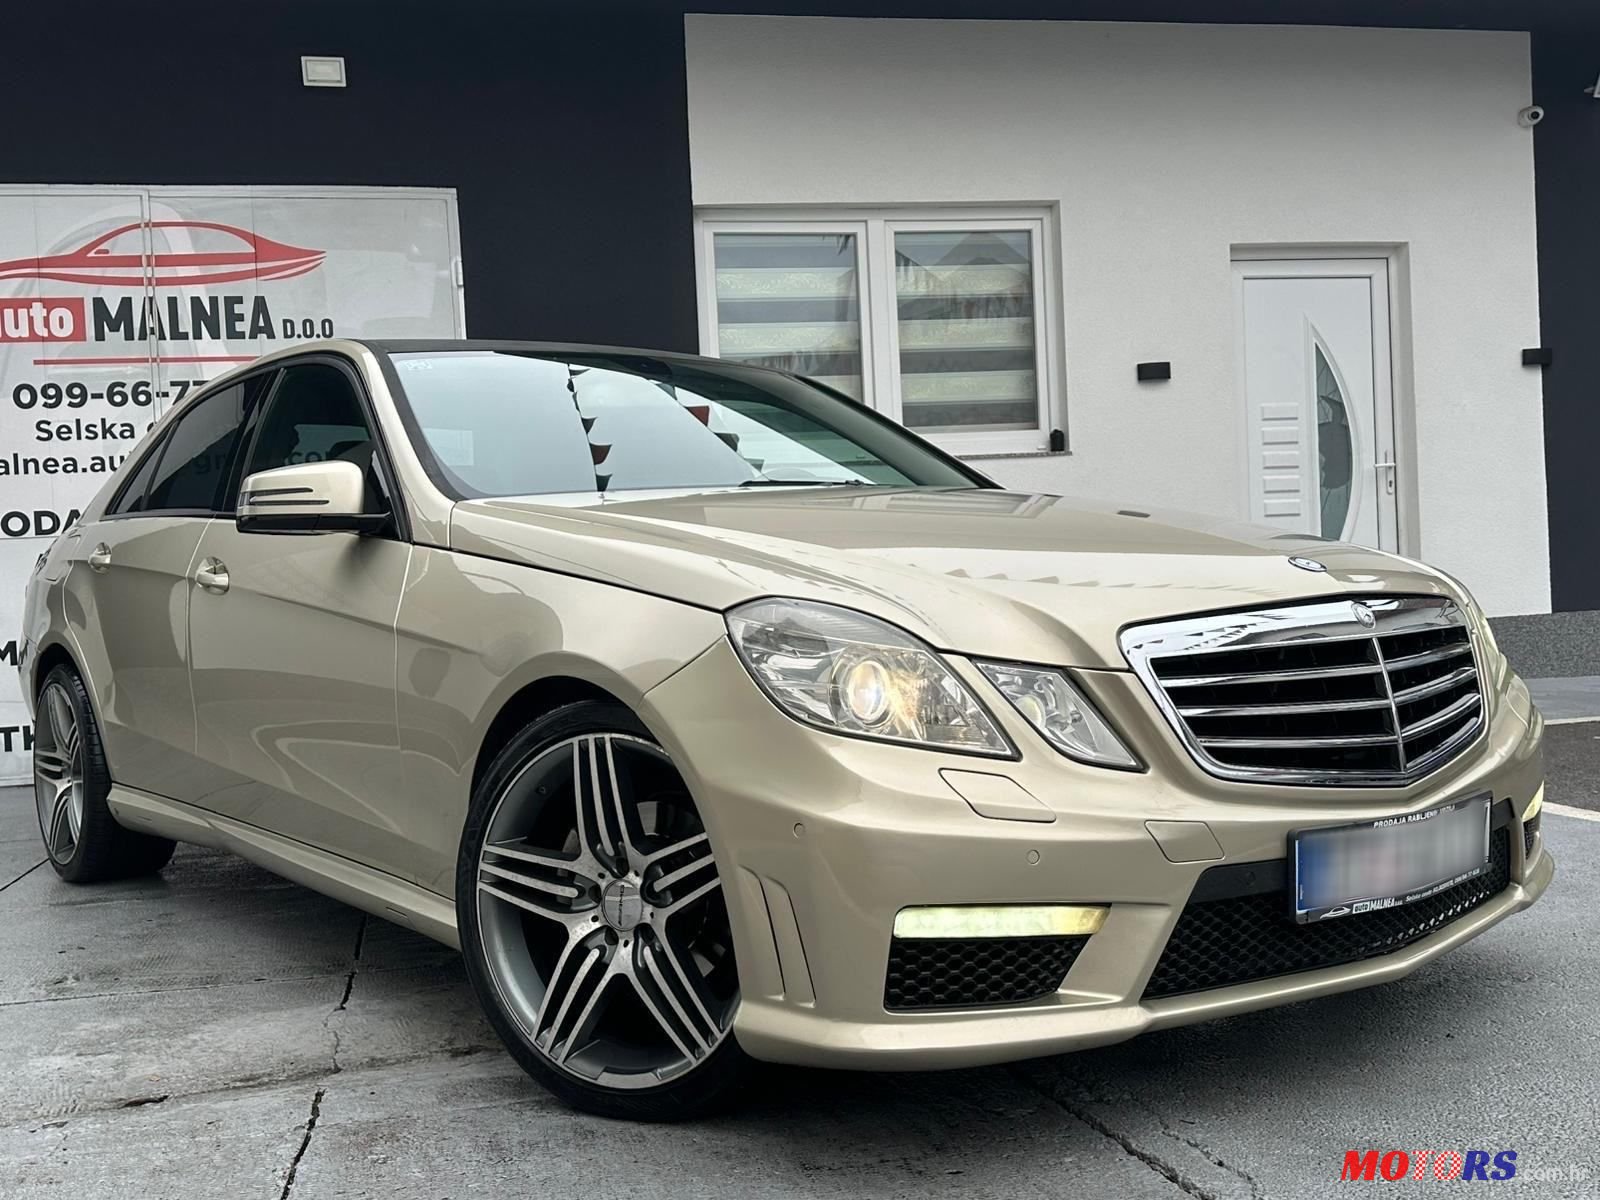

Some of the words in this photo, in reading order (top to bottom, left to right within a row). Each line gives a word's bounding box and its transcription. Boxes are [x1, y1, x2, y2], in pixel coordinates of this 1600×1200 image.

[0, 302, 74, 338] uto
[92, 295, 276, 341] MALNEA
[282, 318, 334, 339] D.O.O
[35, 418, 135, 442] Selska
